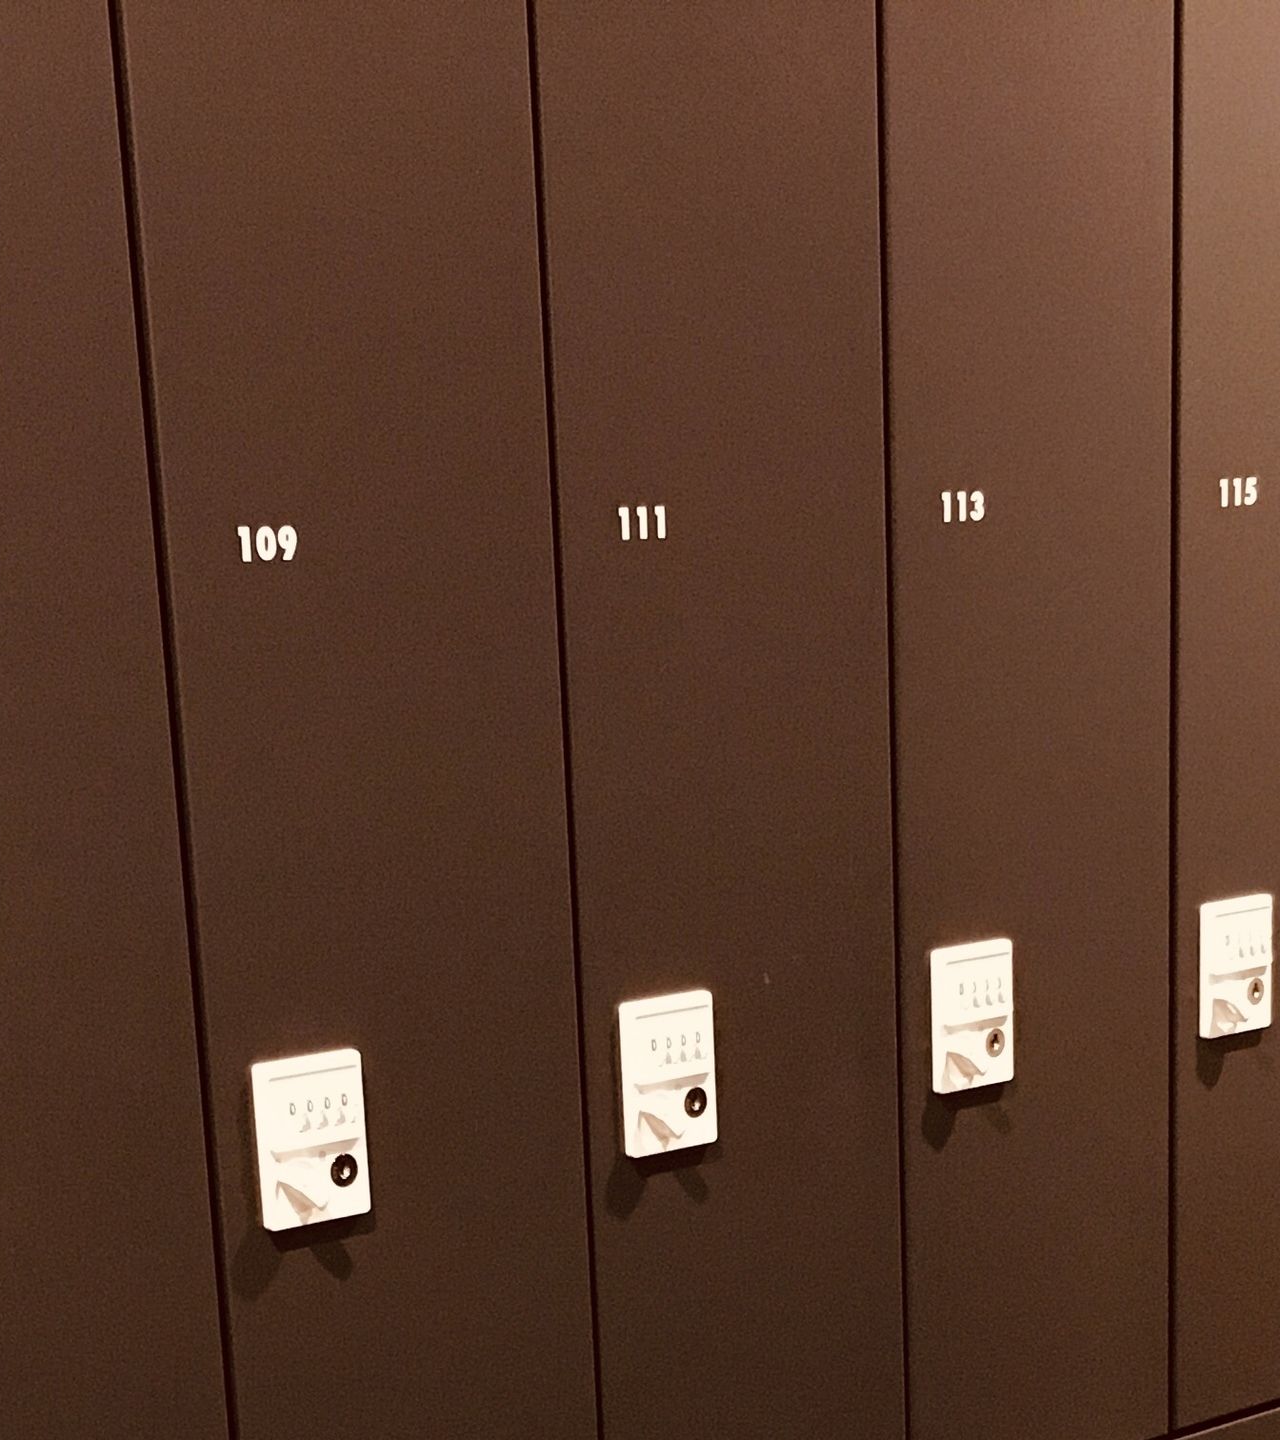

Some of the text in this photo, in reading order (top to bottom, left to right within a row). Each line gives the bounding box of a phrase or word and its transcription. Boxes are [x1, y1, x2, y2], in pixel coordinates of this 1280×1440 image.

[942, 491, 984, 522] 113
[1220, 477, 1257, 507] 115
[619, 506, 665, 540] 111
[238, 525, 297, 562] 109
